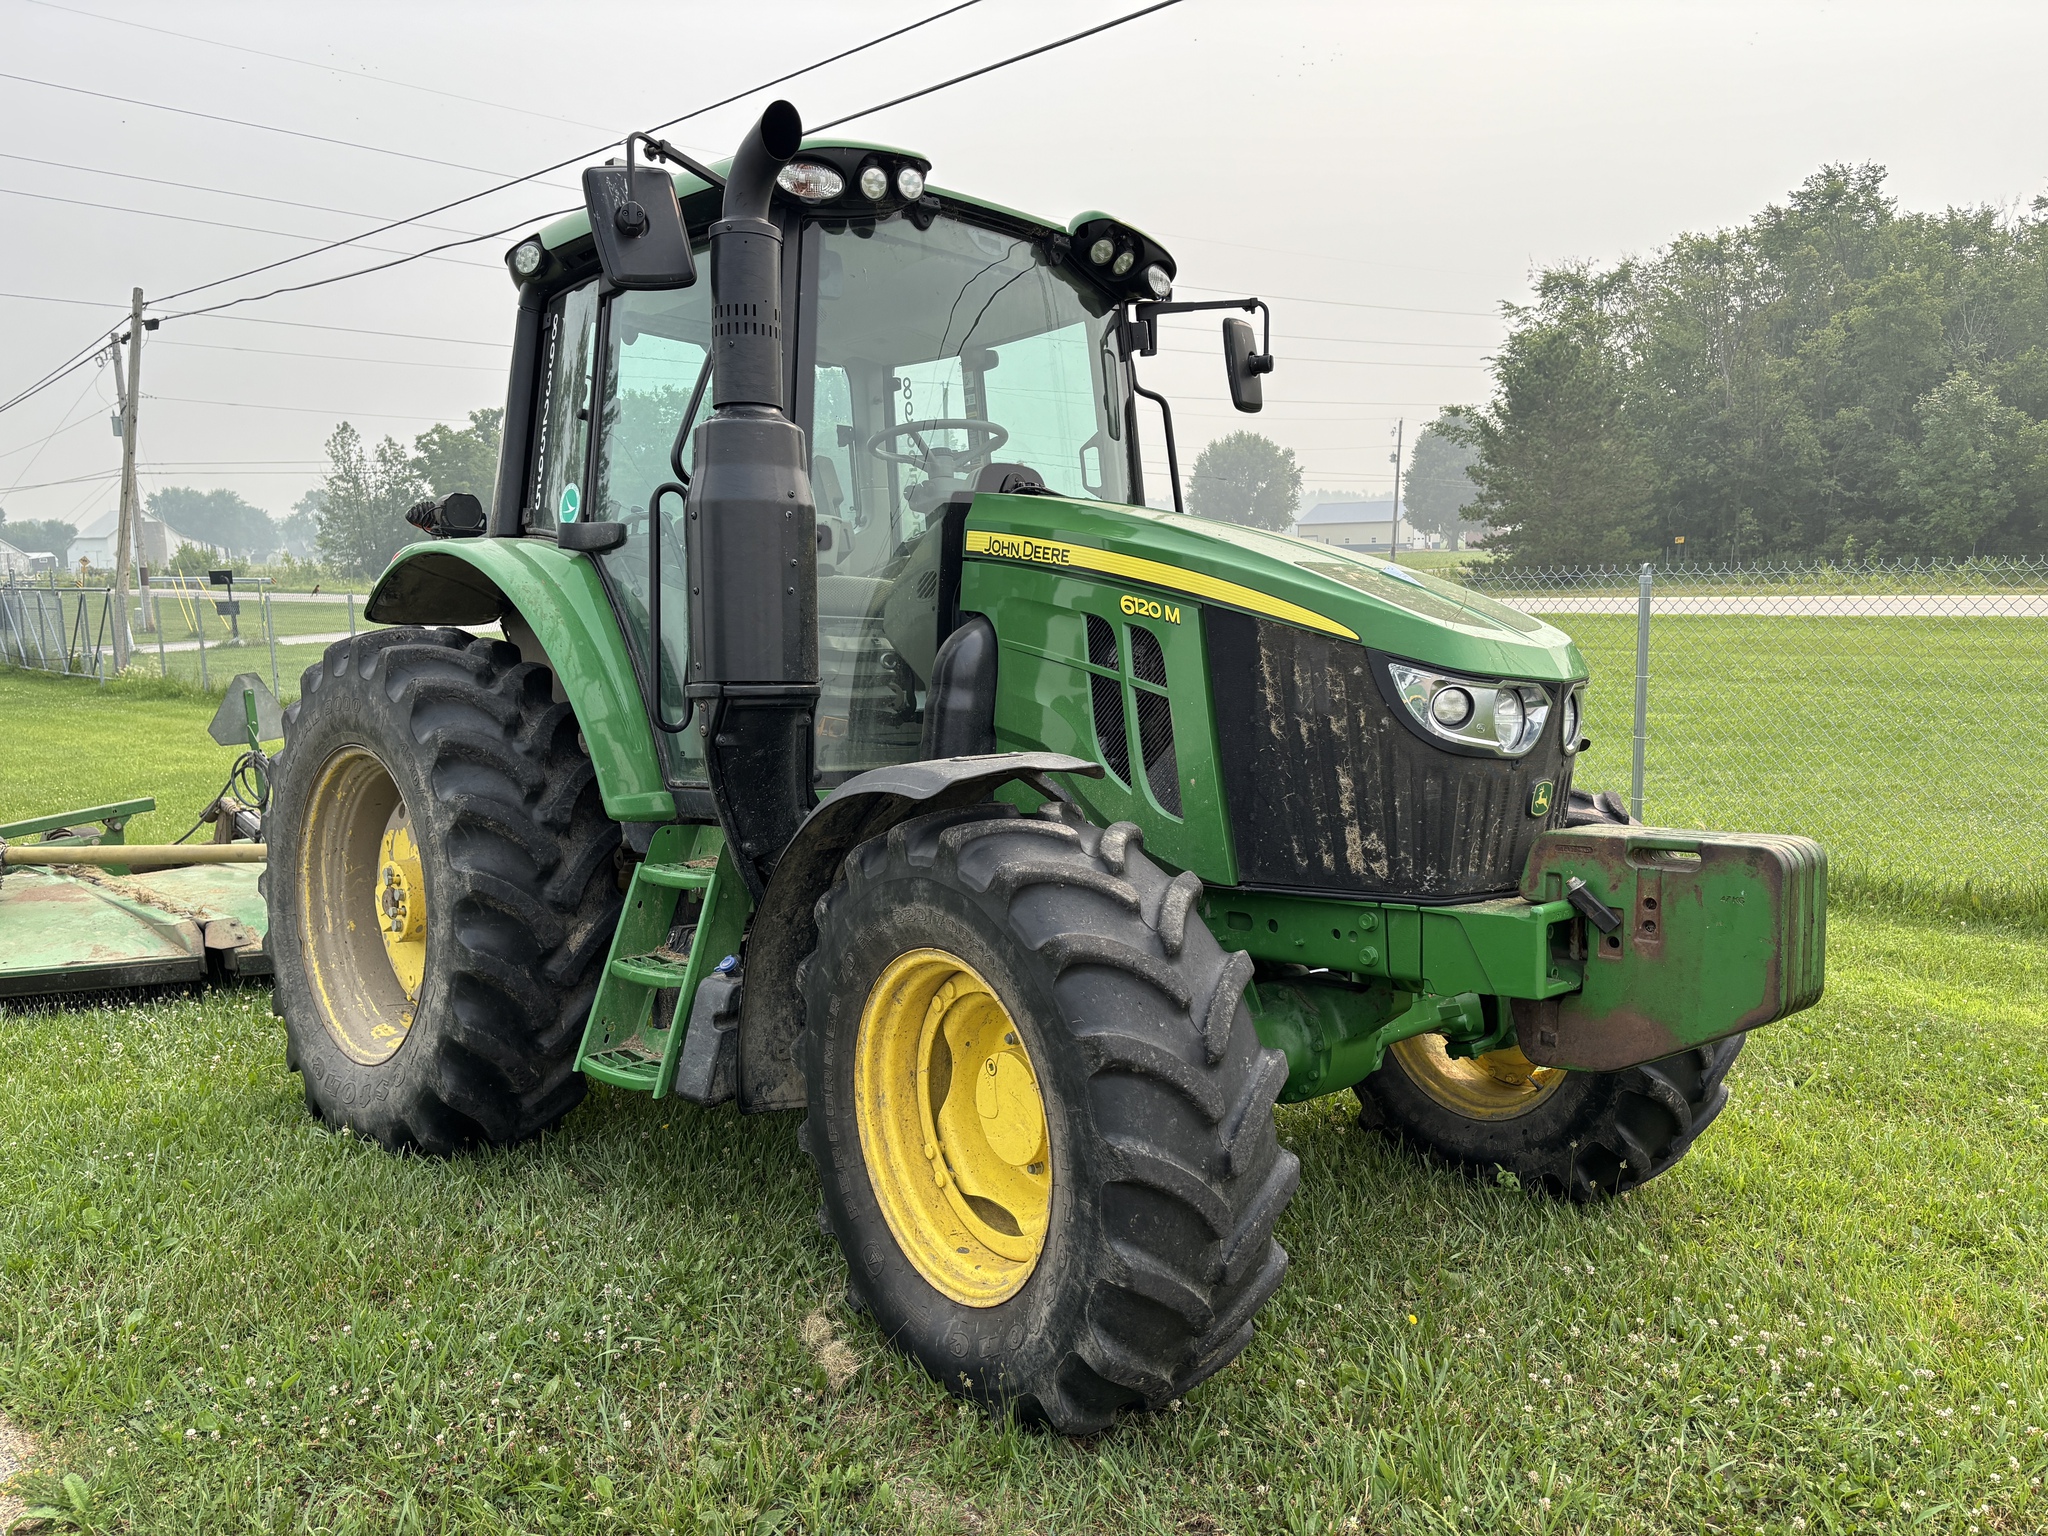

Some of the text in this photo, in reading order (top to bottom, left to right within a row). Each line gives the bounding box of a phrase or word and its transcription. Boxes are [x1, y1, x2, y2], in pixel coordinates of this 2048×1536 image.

[535, 313, 559, 511] 8932595
[983, 535, 1071, 564] JOHN DEERE
[1120, 594, 1182, 625] 6120 M
[324, 695, 363, 717] 9000
[823, 993, 860, 1221] PERFORMER
